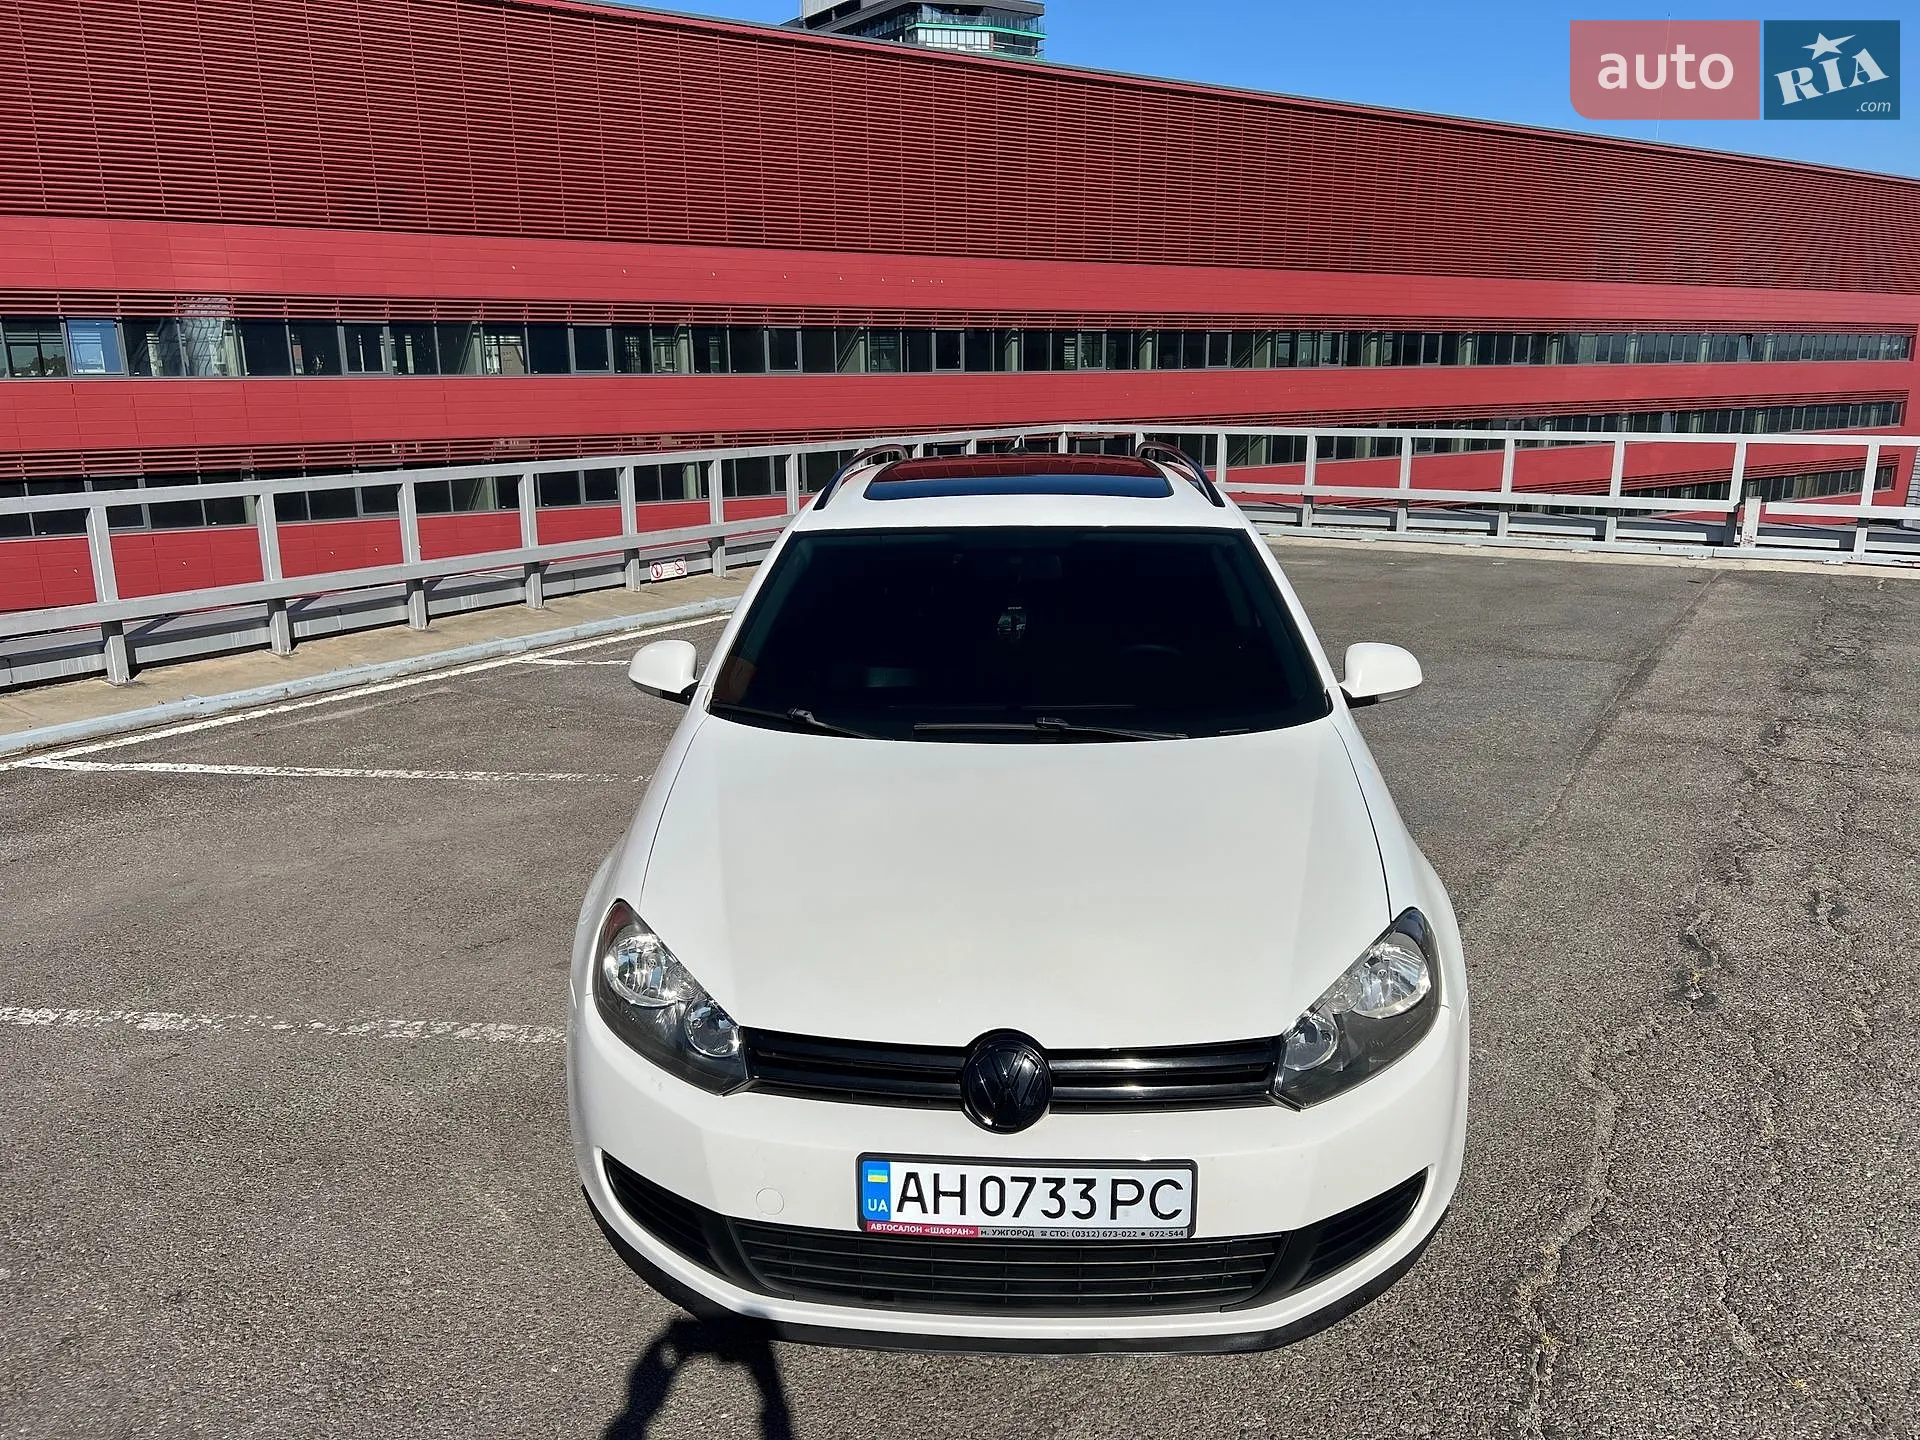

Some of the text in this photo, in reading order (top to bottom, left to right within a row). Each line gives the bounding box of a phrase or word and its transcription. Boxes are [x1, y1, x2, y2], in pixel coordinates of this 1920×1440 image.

[896, 1171, 1184, 1221] AH 0733 PC
[868, 1198, 888, 1212] UA
[870, 1223, 975, 1236] АВТОСАЛОН «ШАФРАН»
[991, 1229, 1035, 1238] УЖГОРОД
[1049, 1230, 1070, 1238] СТО:
[1071, 1230, 1100, 1239] (0312)
[1102, 1230, 1137, 1238] 673-022
[1149, 1230, 1184, 1238] 672-544
